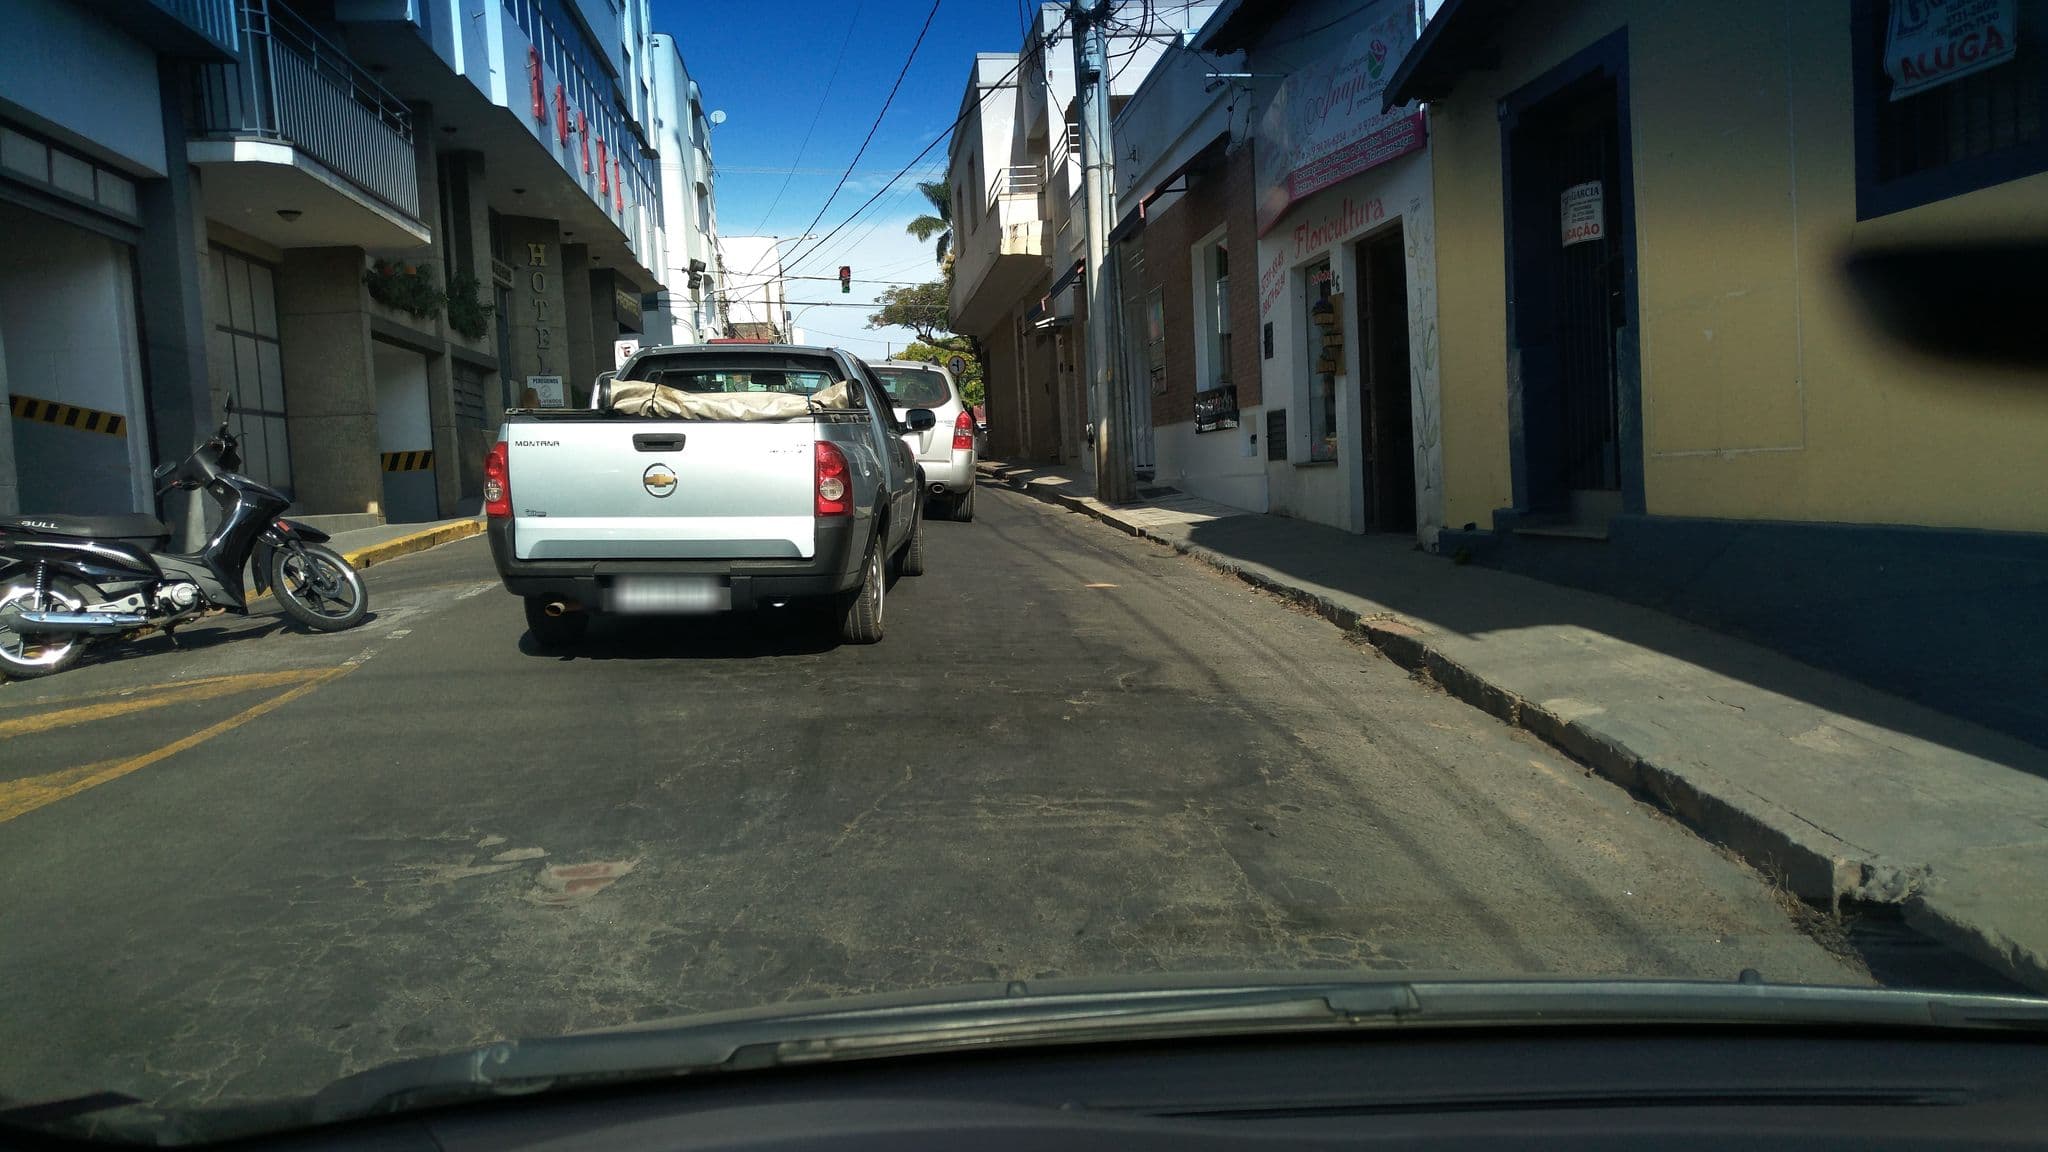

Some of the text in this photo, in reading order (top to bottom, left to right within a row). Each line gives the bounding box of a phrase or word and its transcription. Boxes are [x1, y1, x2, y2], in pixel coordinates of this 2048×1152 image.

[1902, 25, 2004, 84] ALUGA
[1295, 197, 1384, 258] Floricultura
[527, 241, 551, 376] HOTEL
[21, 520, 59, 530] BULL
